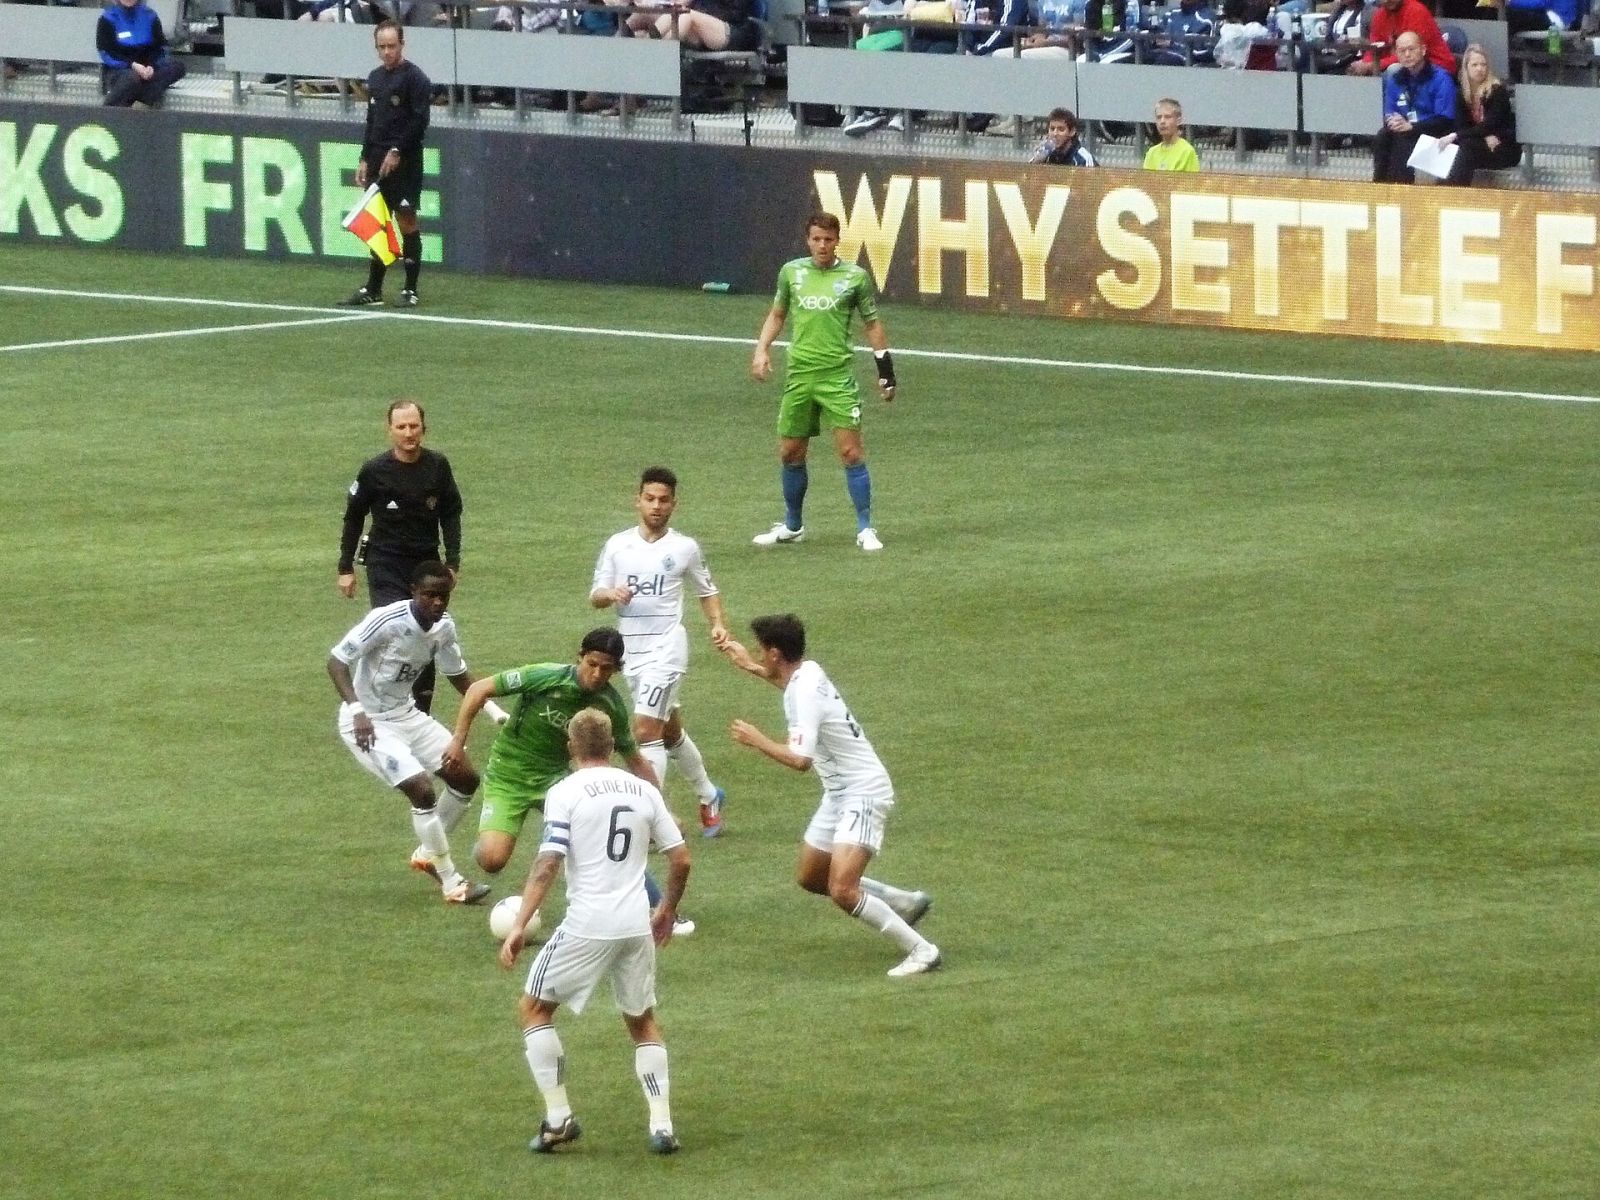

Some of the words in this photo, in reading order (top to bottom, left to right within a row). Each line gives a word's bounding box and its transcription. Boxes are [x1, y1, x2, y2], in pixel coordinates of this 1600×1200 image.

[813, 170, 1071, 301] WHY
[1095, 187, 1503, 331] SETTLE
[1535, 211, 1598, 334] F
[797, 295, 840, 310] XBOX
[627, 574, 664, 596] Bell
[606, 805, 634, 862] 6
